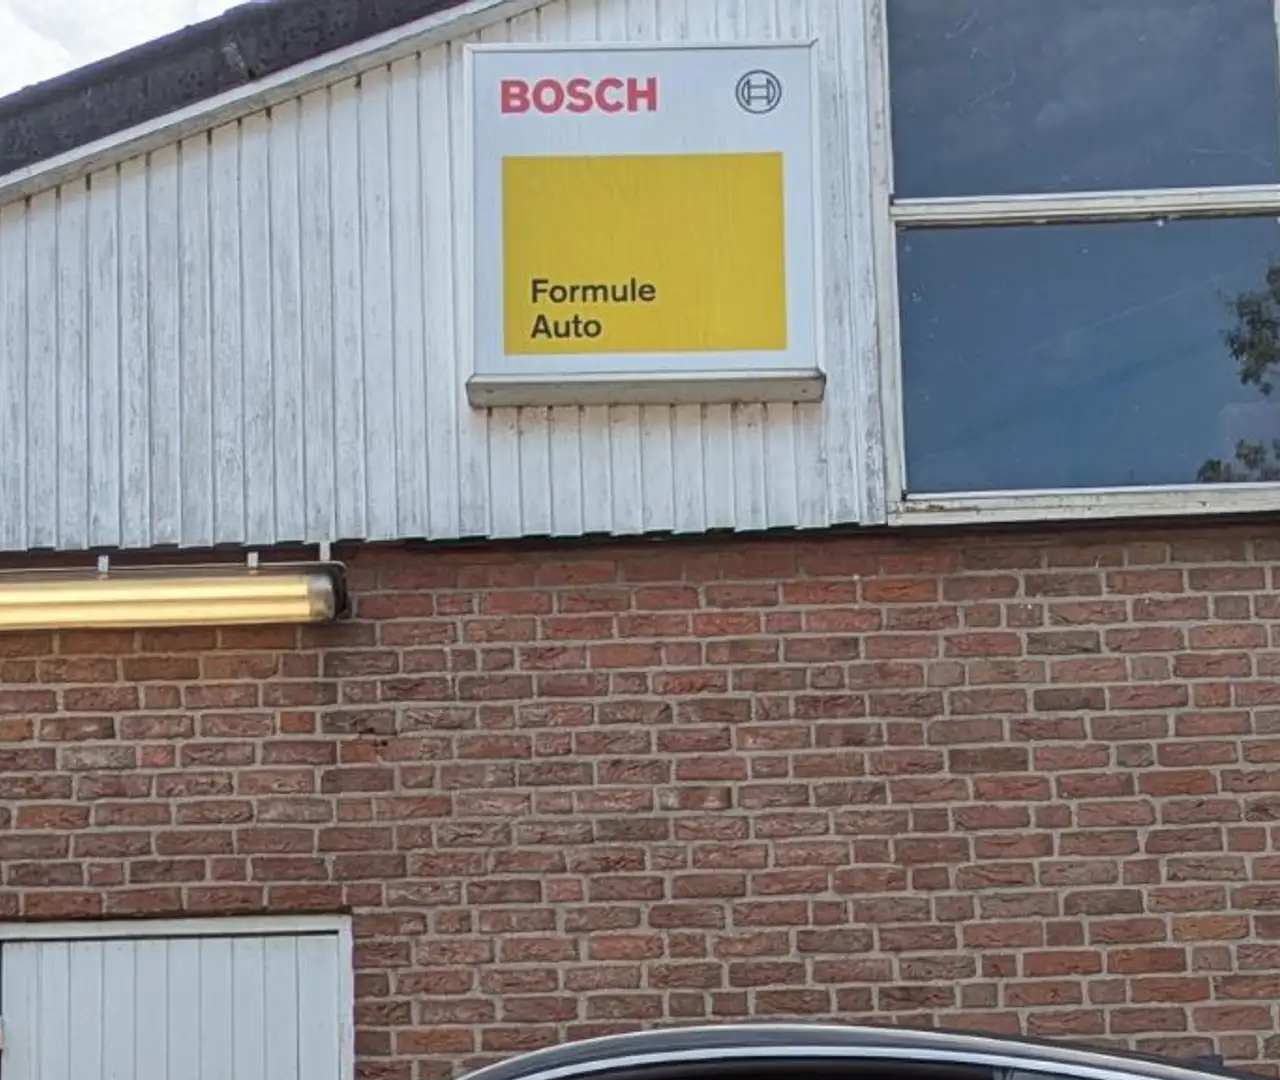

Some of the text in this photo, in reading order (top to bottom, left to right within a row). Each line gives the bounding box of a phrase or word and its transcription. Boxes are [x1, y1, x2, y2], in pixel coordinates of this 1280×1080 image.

[499, 76, 658, 115] BOSCH
[530, 276, 657, 304] Formule
[530, 313, 602, 340] Auto
